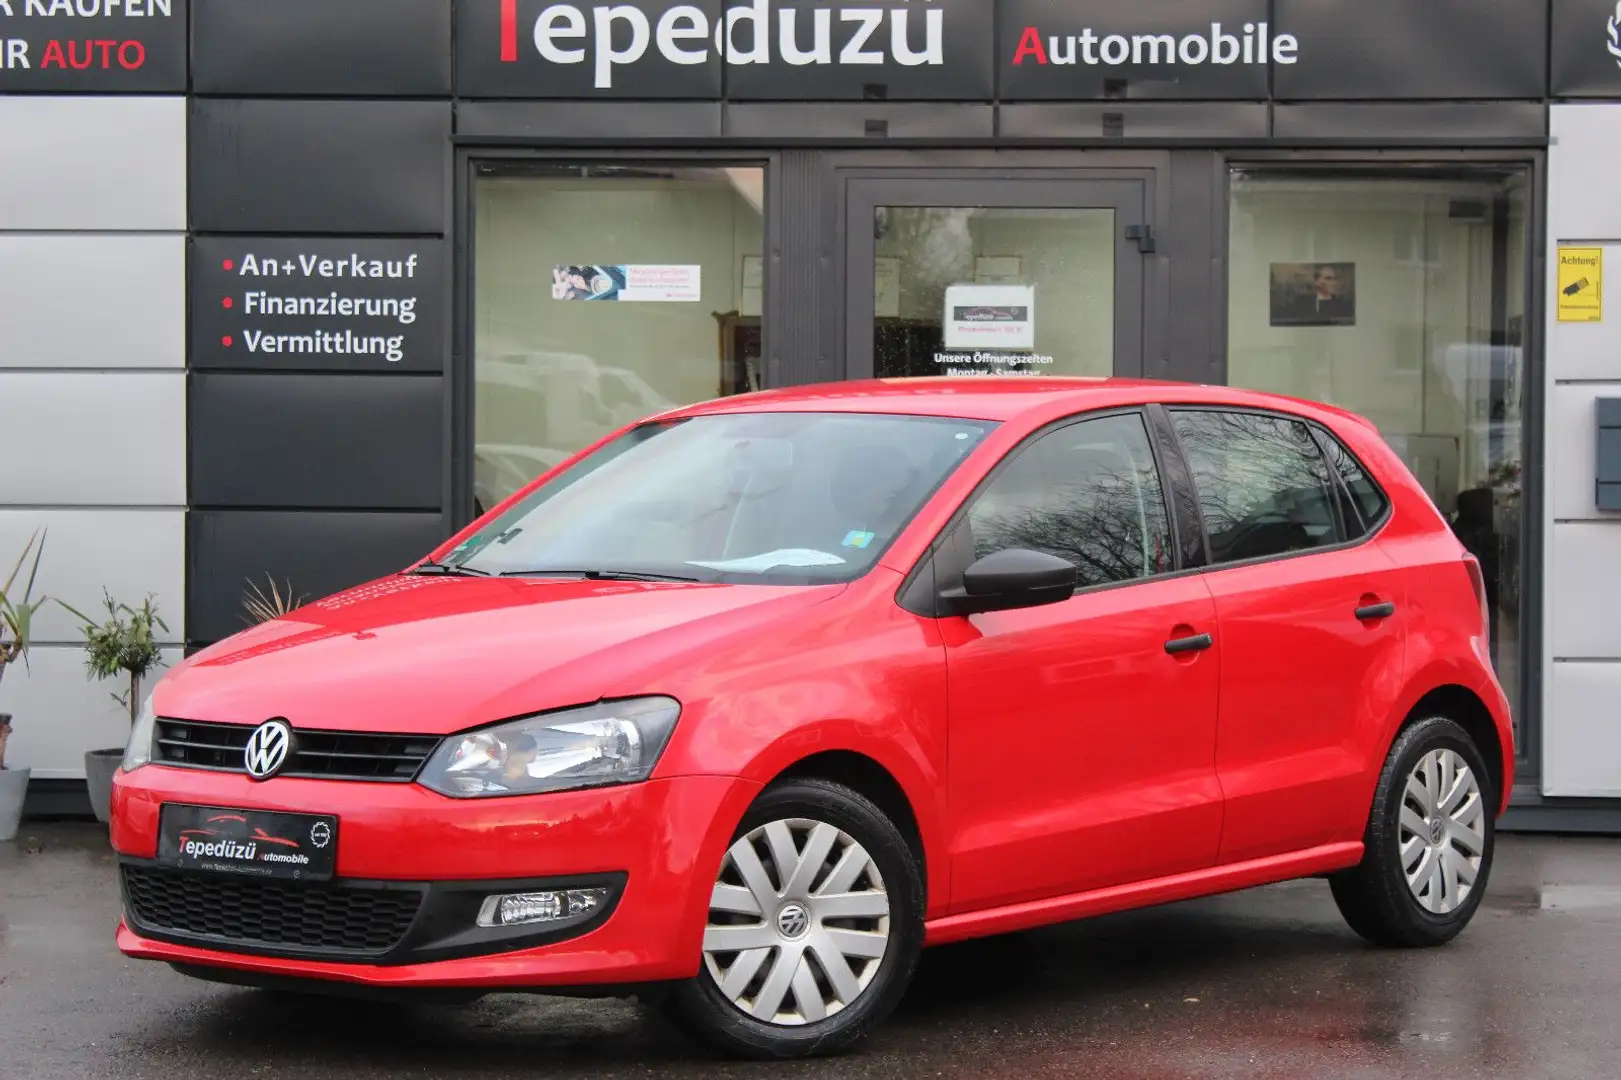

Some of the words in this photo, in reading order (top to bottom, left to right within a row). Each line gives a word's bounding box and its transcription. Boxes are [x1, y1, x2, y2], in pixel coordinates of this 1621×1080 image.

[0, 39, 31, 69] R
[40, 39, 145, 70] AUTO
[1012, 22, 1299, 65] Automobile
[239, 253, 418, 278] An+Verkauf
[244, 291, 417, 324] Finanzierung
[243, 330, 404, 361] Vermittlung
[934, 353, 971, 363] Unsere
[973, 351, 1053, 366] Öffnungszeiten
[179, 836, 257, 860] Tepedüzü
[258, 851, 309, 865] Automobile
